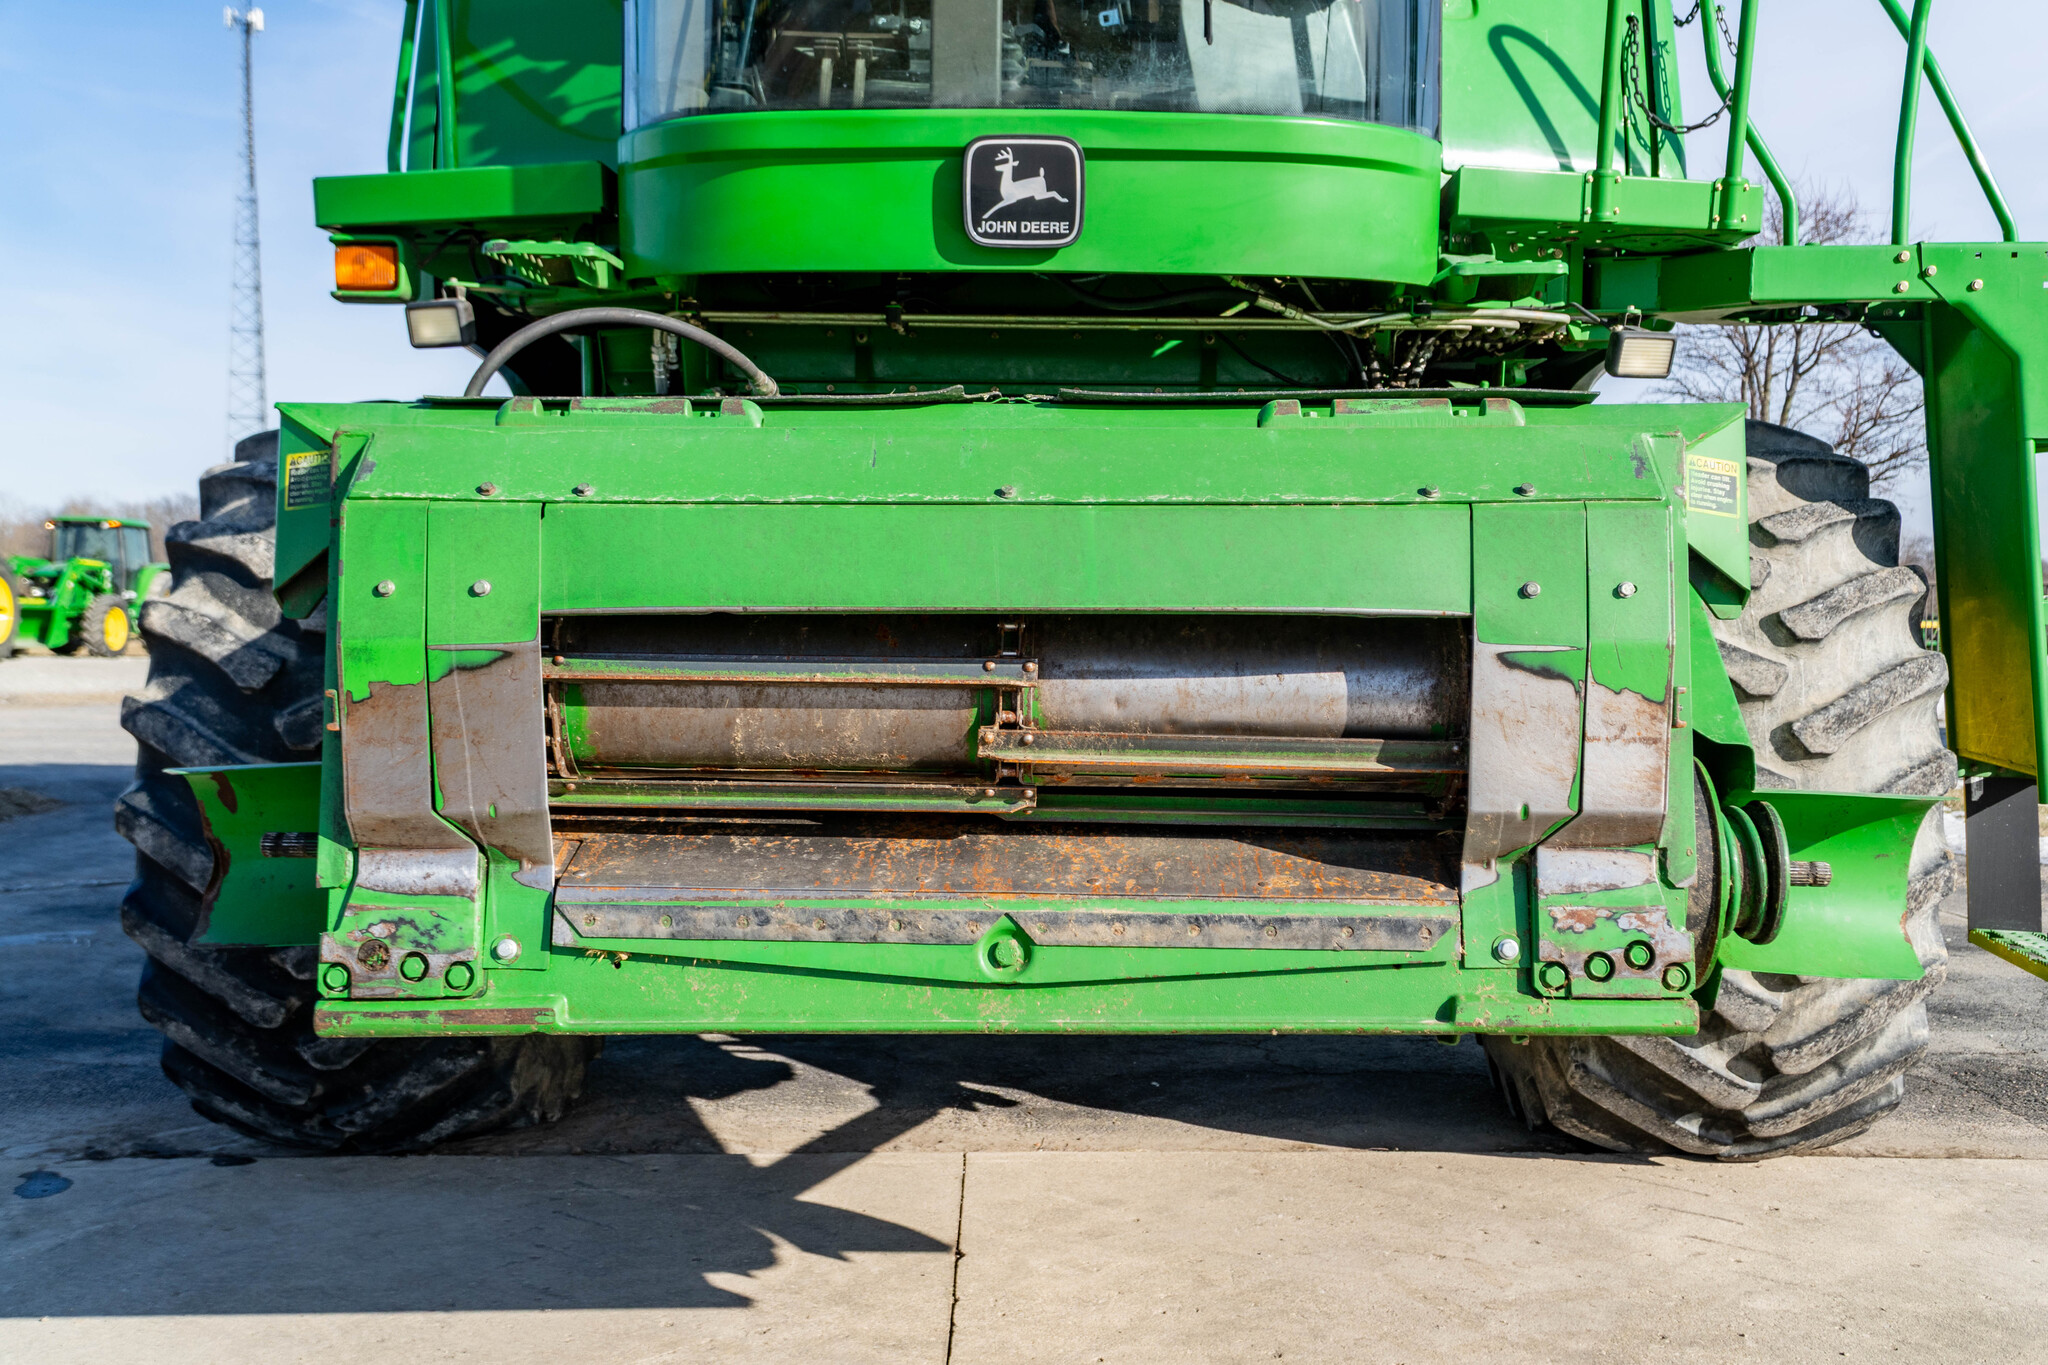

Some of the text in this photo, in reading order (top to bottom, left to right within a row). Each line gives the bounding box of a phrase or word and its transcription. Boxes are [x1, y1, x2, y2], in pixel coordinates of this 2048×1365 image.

[977, 221, 1070, 234] JOHN DEERE
[1696, 458, 1737, 474] CAUTION
[1707, 481, 1730, 490] crushing
[1713, 488, 1726, 496] Stay
